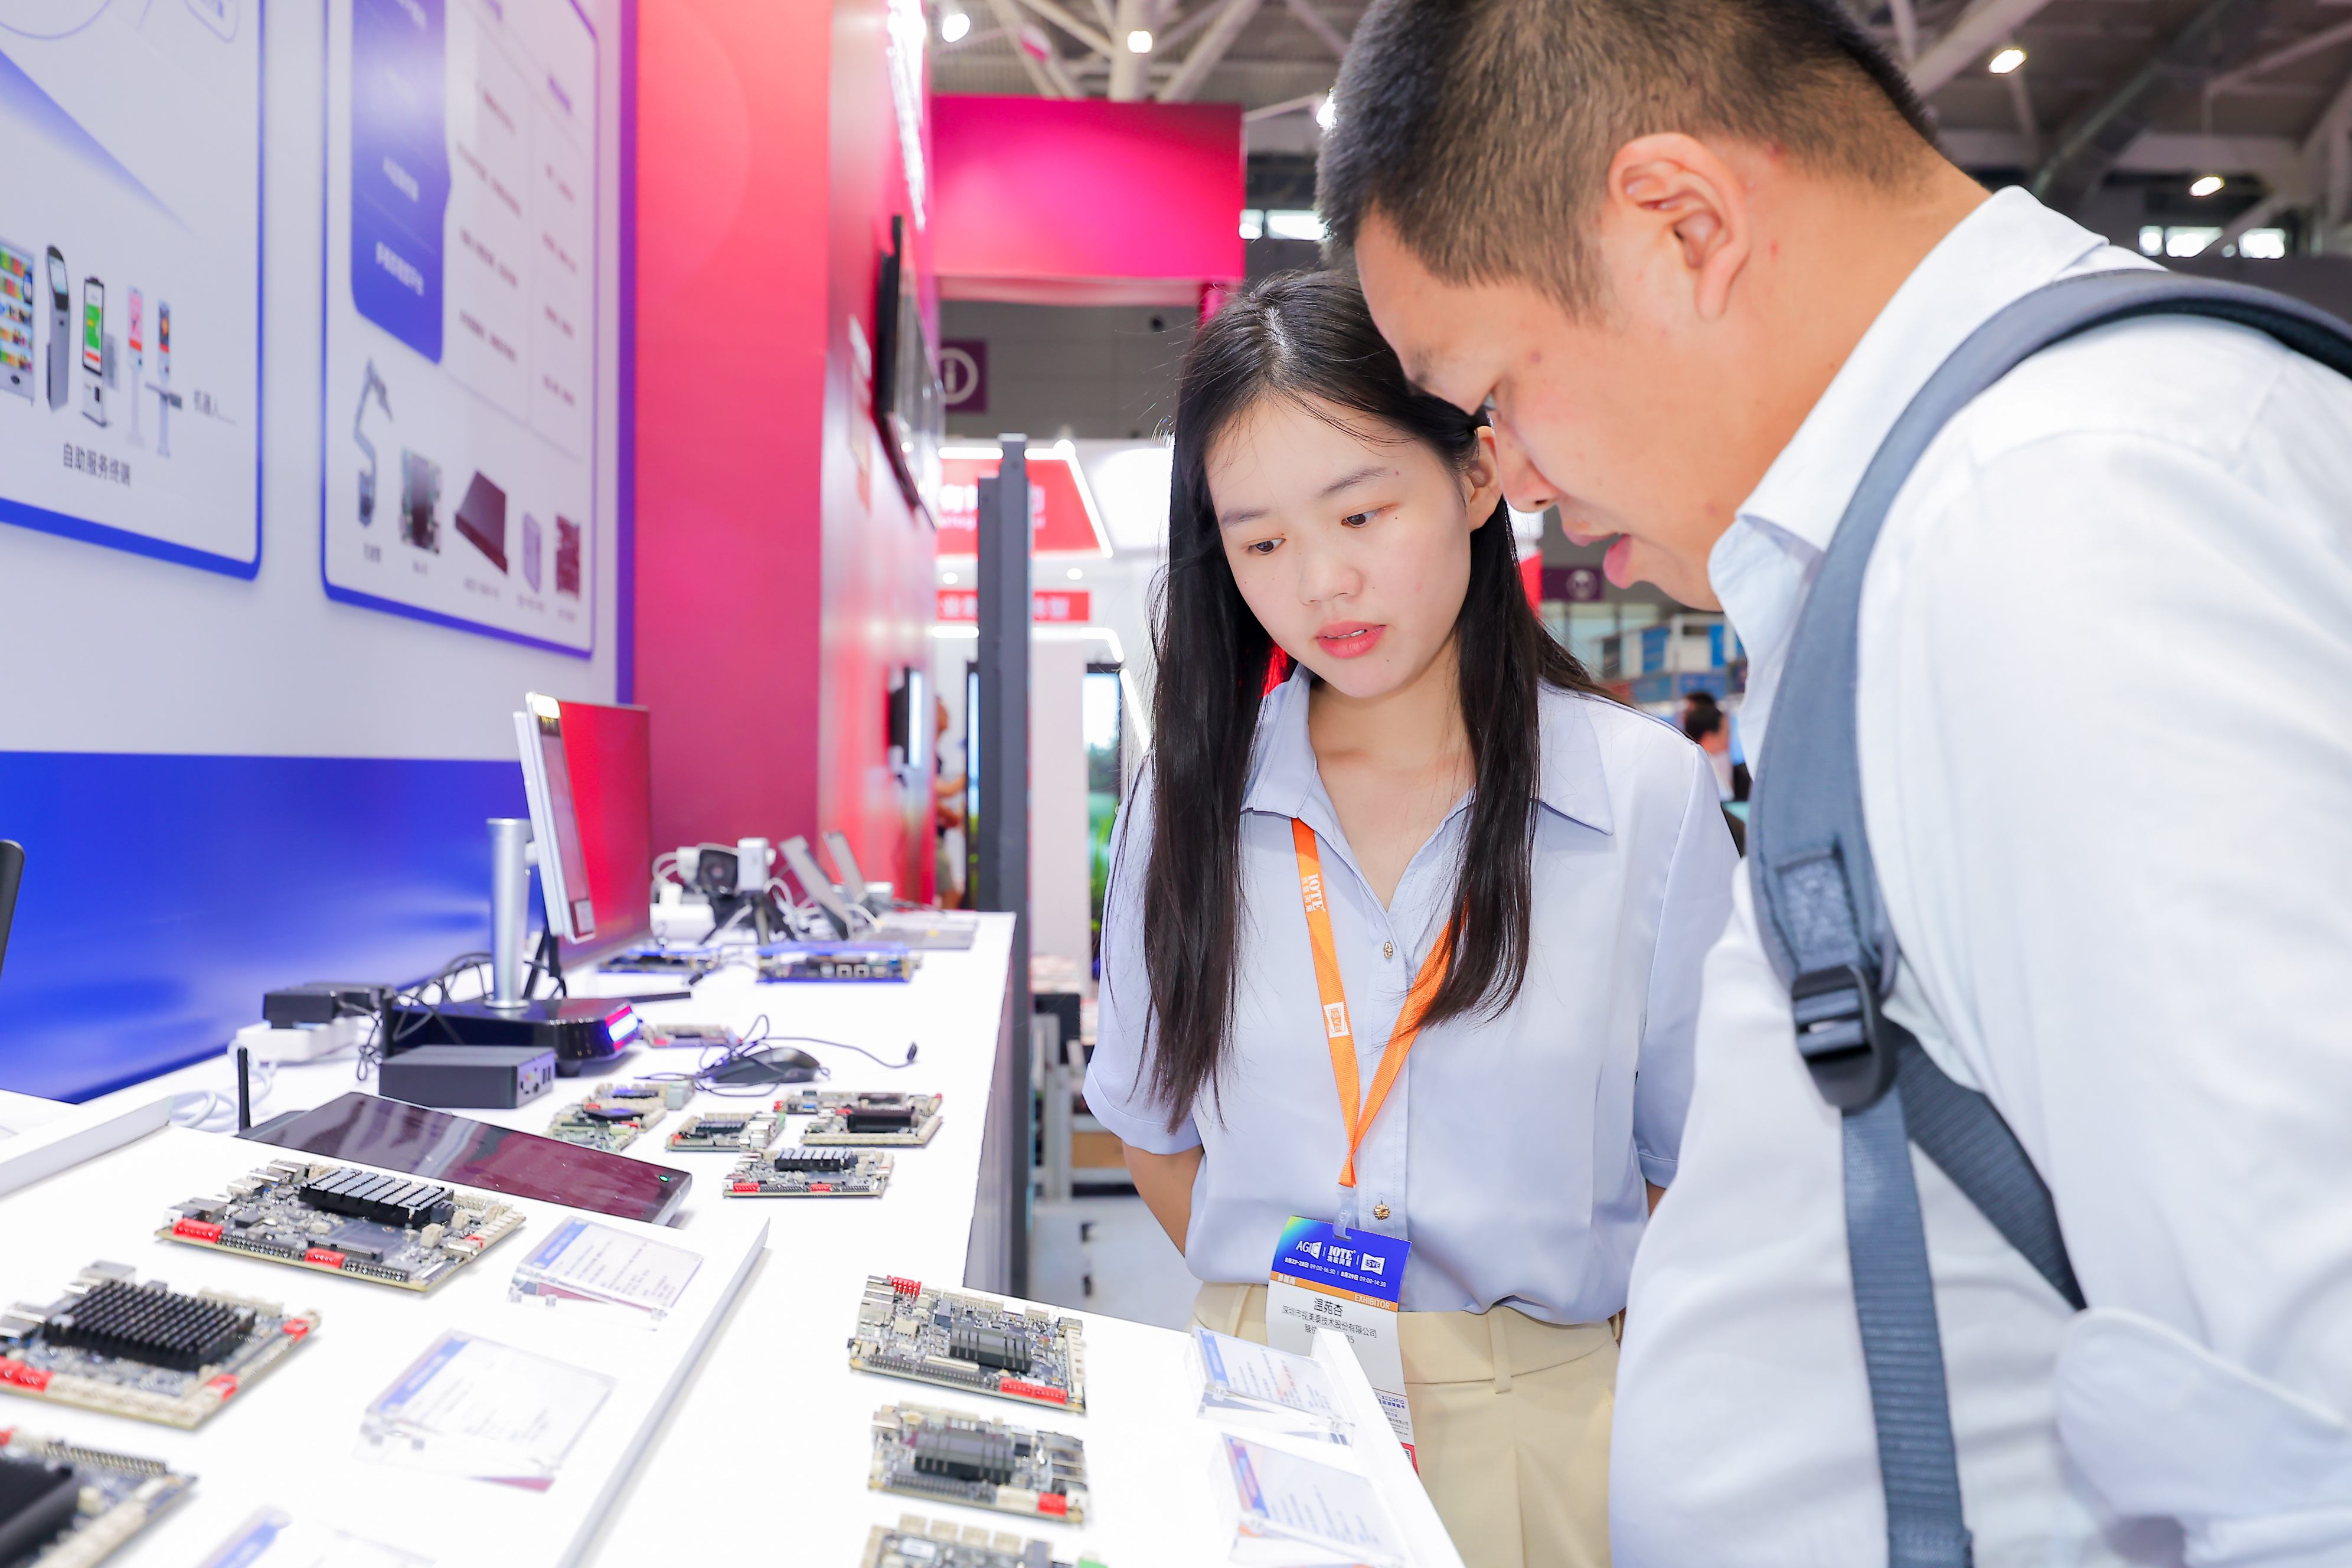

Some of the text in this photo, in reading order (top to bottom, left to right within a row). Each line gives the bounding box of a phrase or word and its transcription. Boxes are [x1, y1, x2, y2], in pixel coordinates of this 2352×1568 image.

[63, 442, 131, 486] 自助服务终端
[1314, 1297, 1344, 1318] 温苑杏
[1354, 1293, 1390, 1310] EXHIBITOR
